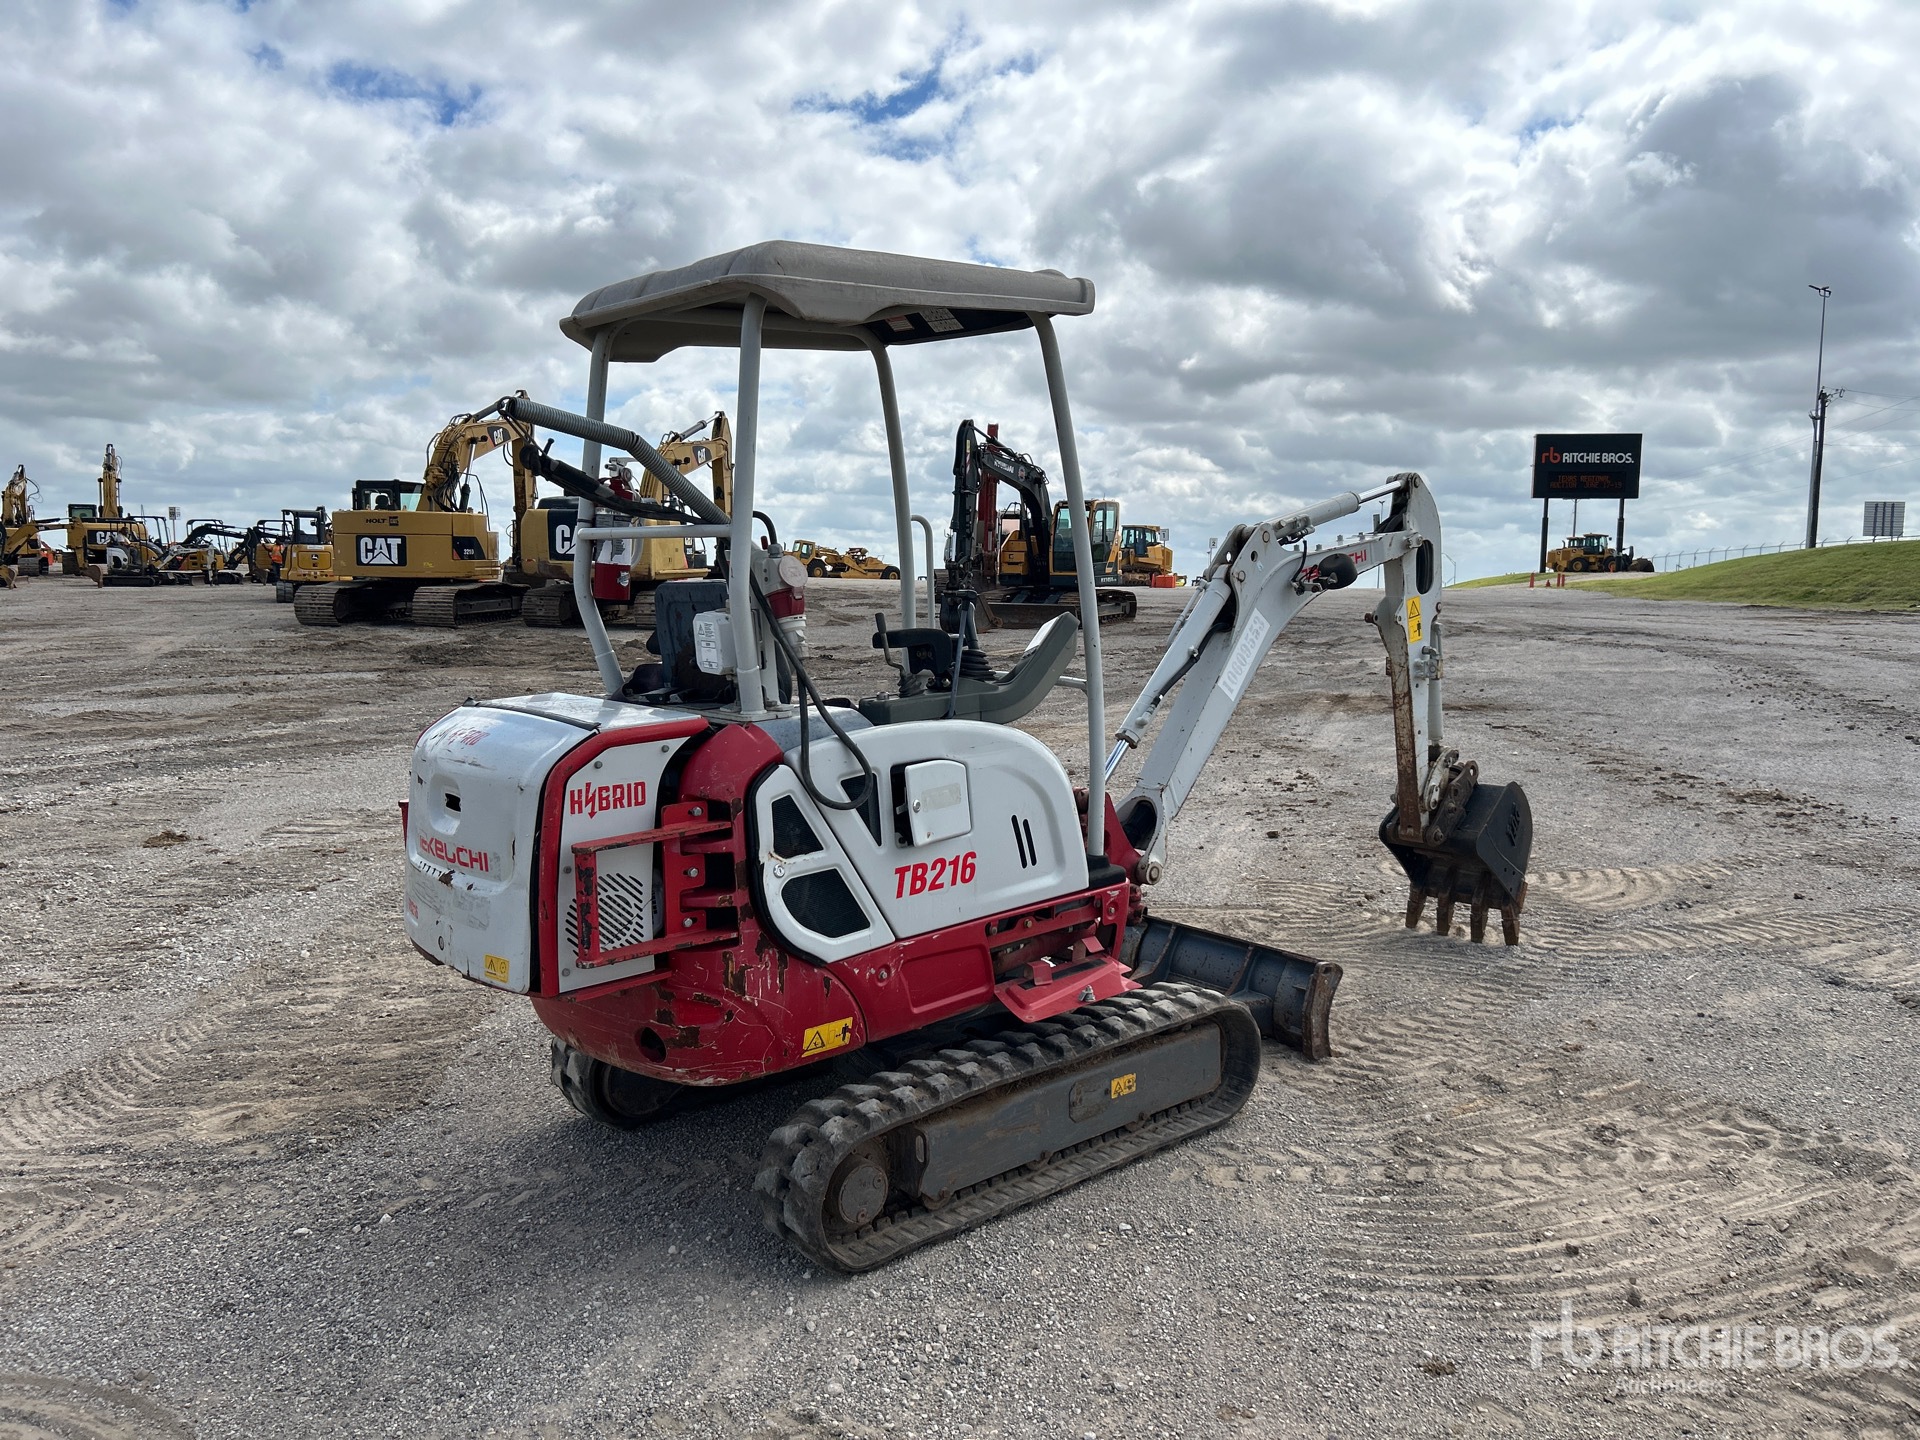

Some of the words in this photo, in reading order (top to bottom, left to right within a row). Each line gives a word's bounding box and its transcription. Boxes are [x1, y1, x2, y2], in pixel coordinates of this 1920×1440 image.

[1541, 447, 1561, 464] rb
[1562, 452, 1600, 463] RITCHIE
[1602, 452, 1635, 464] BROS.
[360, 537, 402, 565] CAT
[569, 781, 647, 819] HYBRID
[894, 851, 977, 899] TB216
